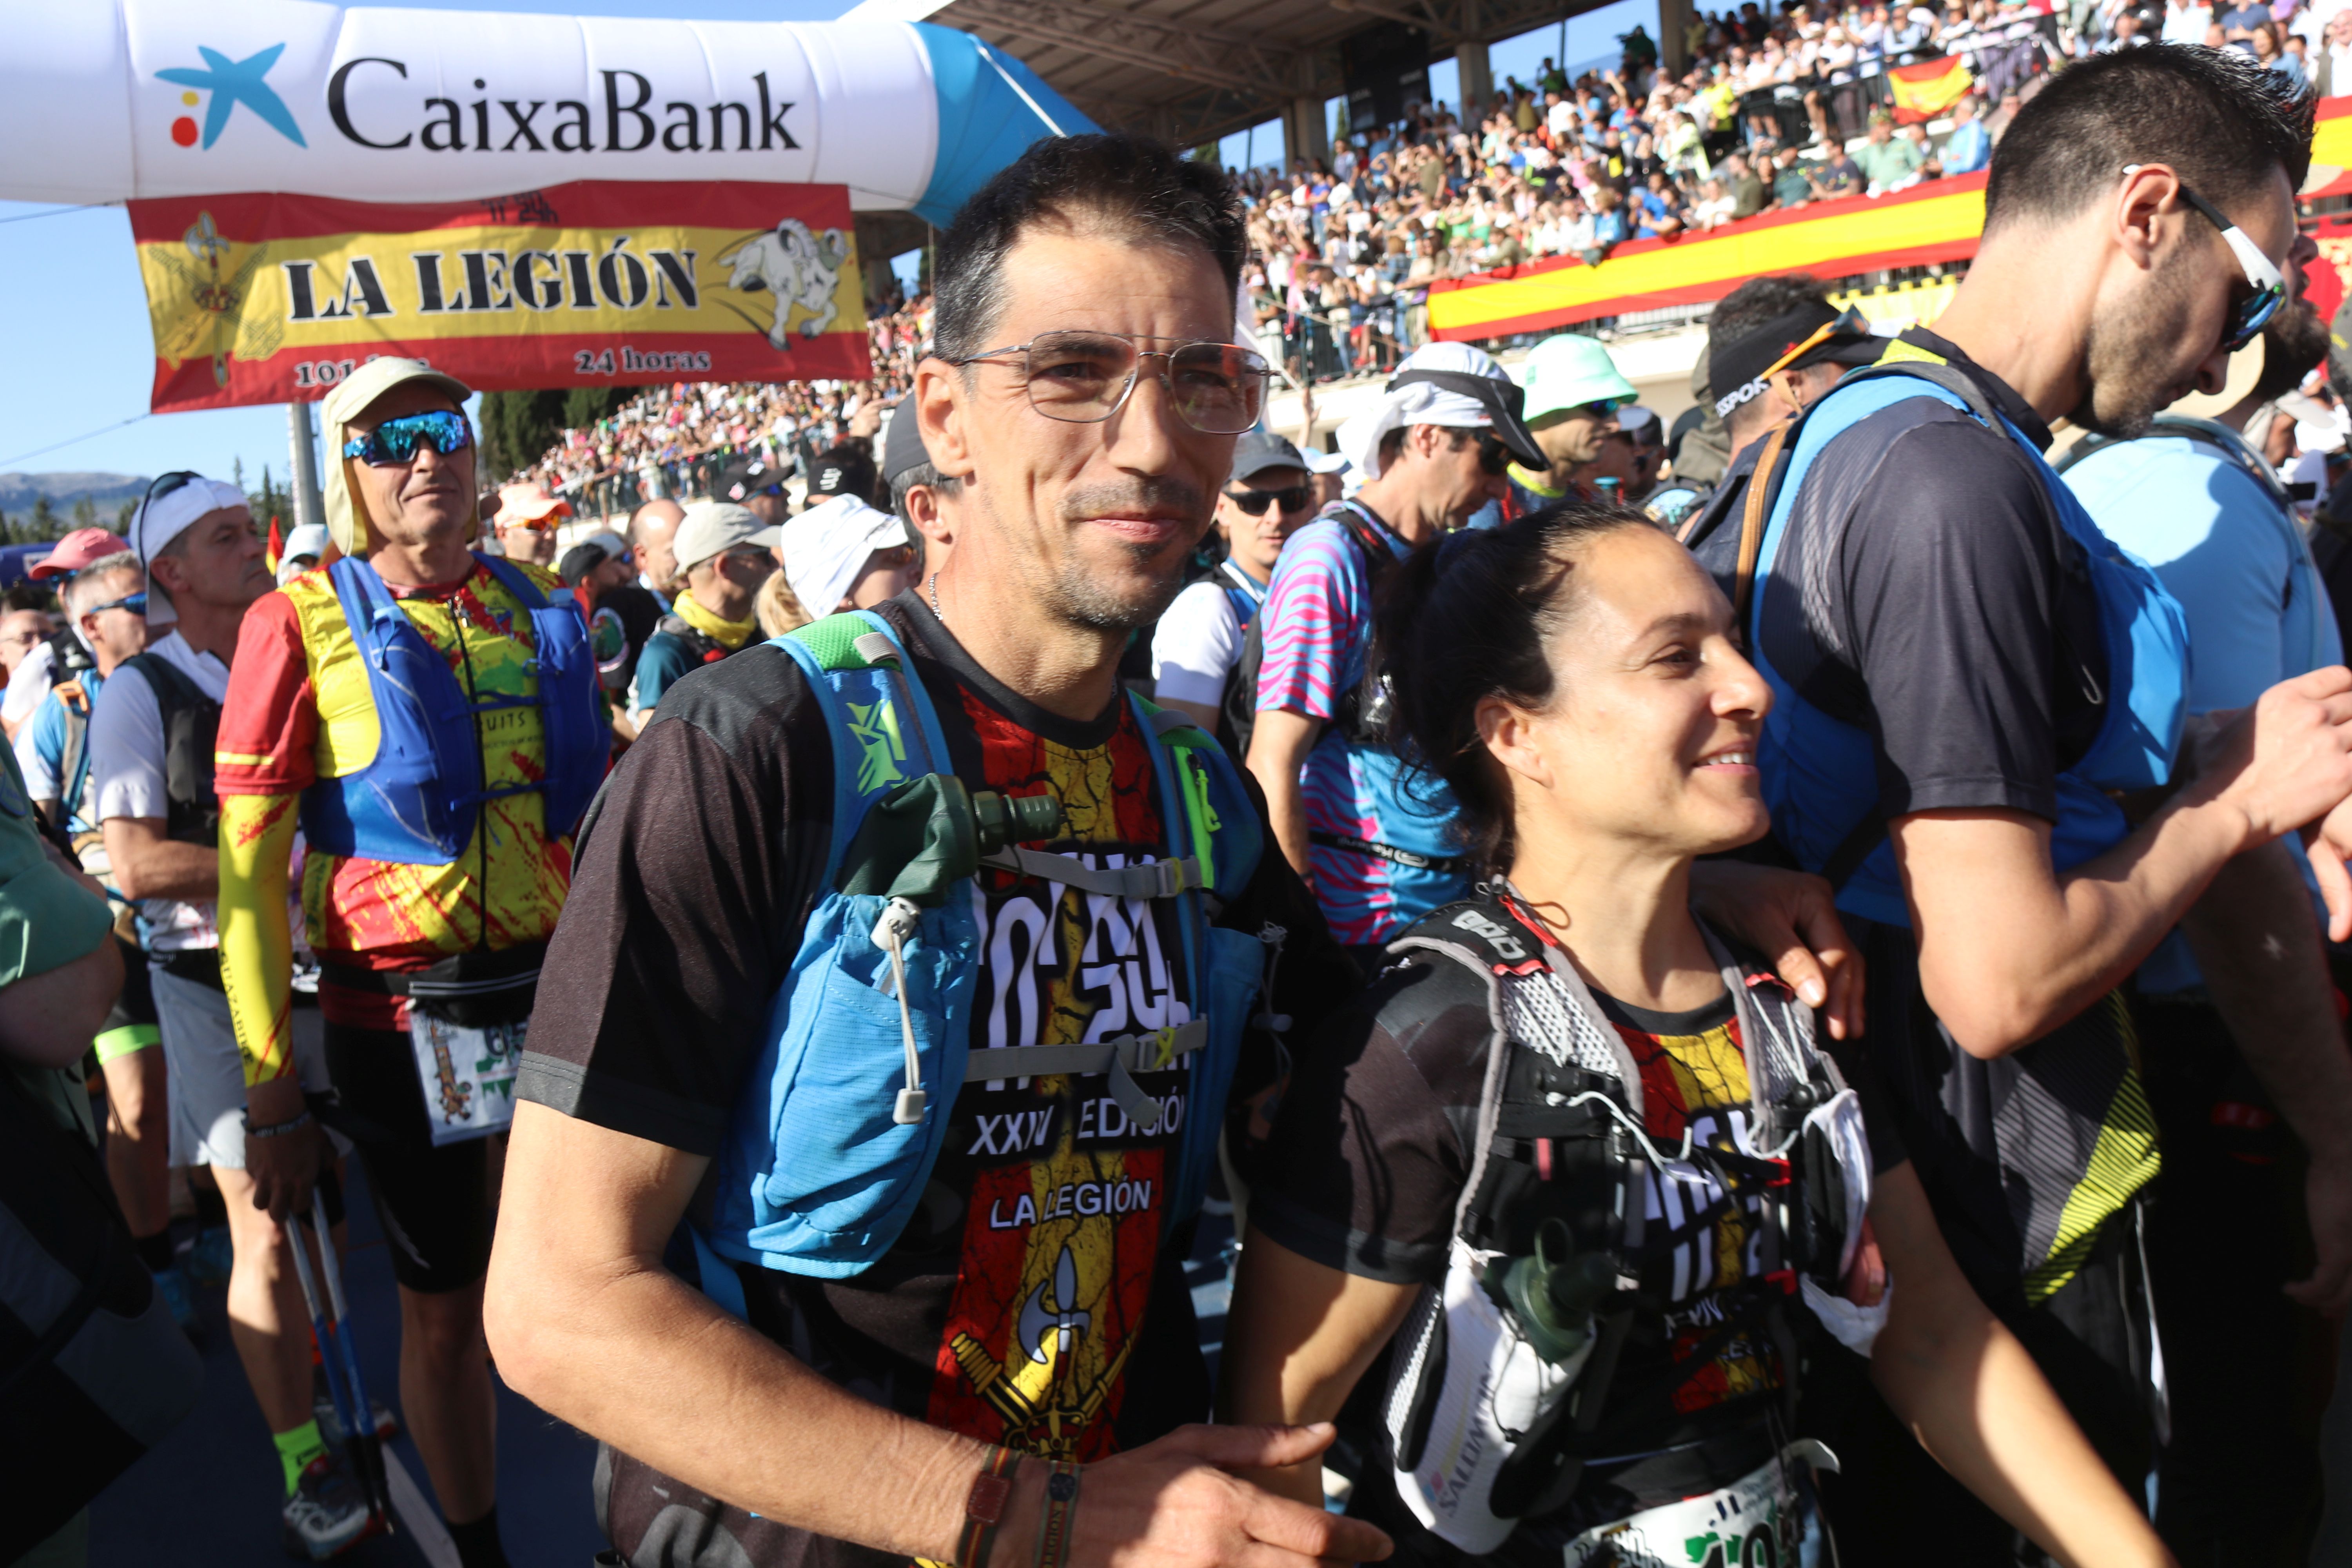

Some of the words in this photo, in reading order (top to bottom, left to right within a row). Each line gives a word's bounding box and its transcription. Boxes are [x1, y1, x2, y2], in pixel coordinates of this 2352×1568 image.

[328, 58, 801, 153] CaixaBank
[282, 256, 396, 323] LA
[410, 236, 699, 313] LEGIÓN
[574, 347, 616, 376] 24
[621, 345, 712, 373] horas
[967, 1105, 1054, 1155] XXIV
[990, 1194, 1036, 1229] LA
[1042, 1175, 1151, 1221] LEGIÓN
